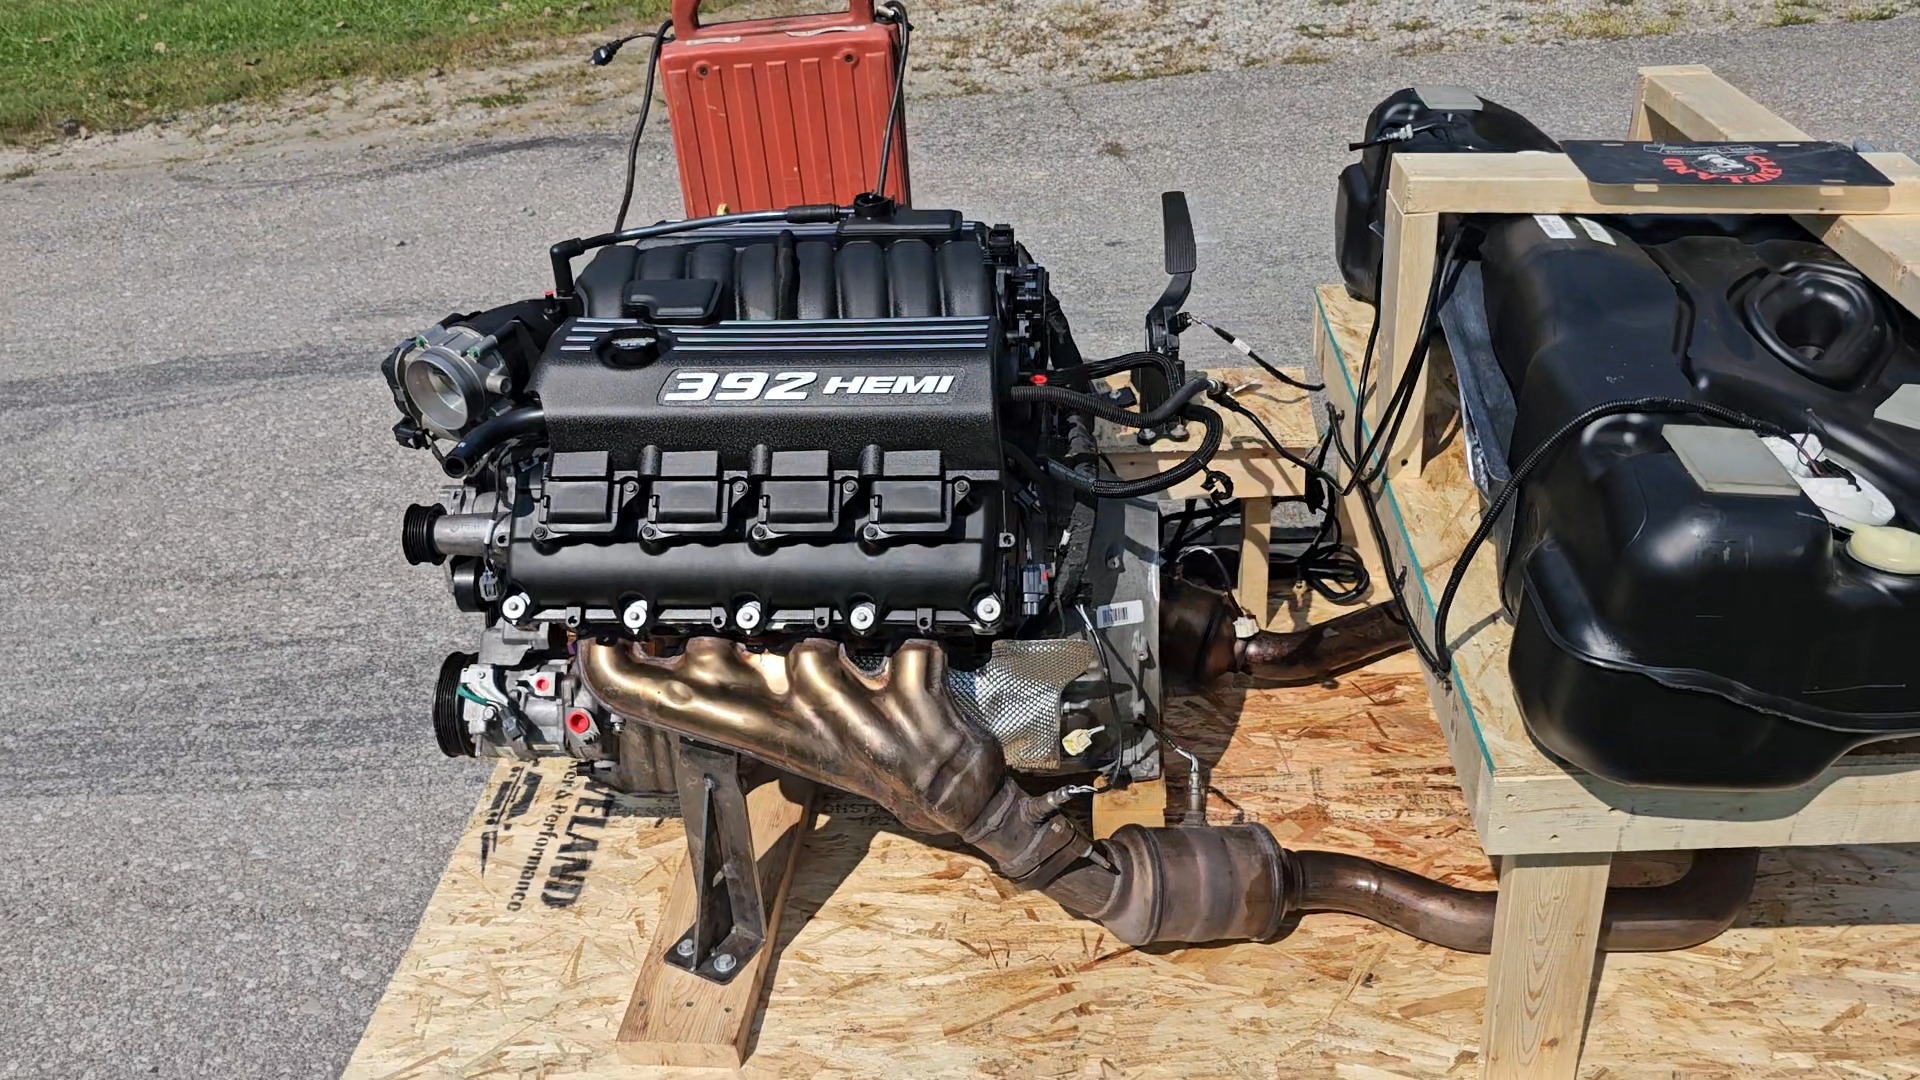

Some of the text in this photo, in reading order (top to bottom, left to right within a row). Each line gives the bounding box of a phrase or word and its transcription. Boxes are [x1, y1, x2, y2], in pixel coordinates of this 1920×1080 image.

[664, 372, 955, 401] 392 HEMI
[507, 803, 568, 912] Performance
